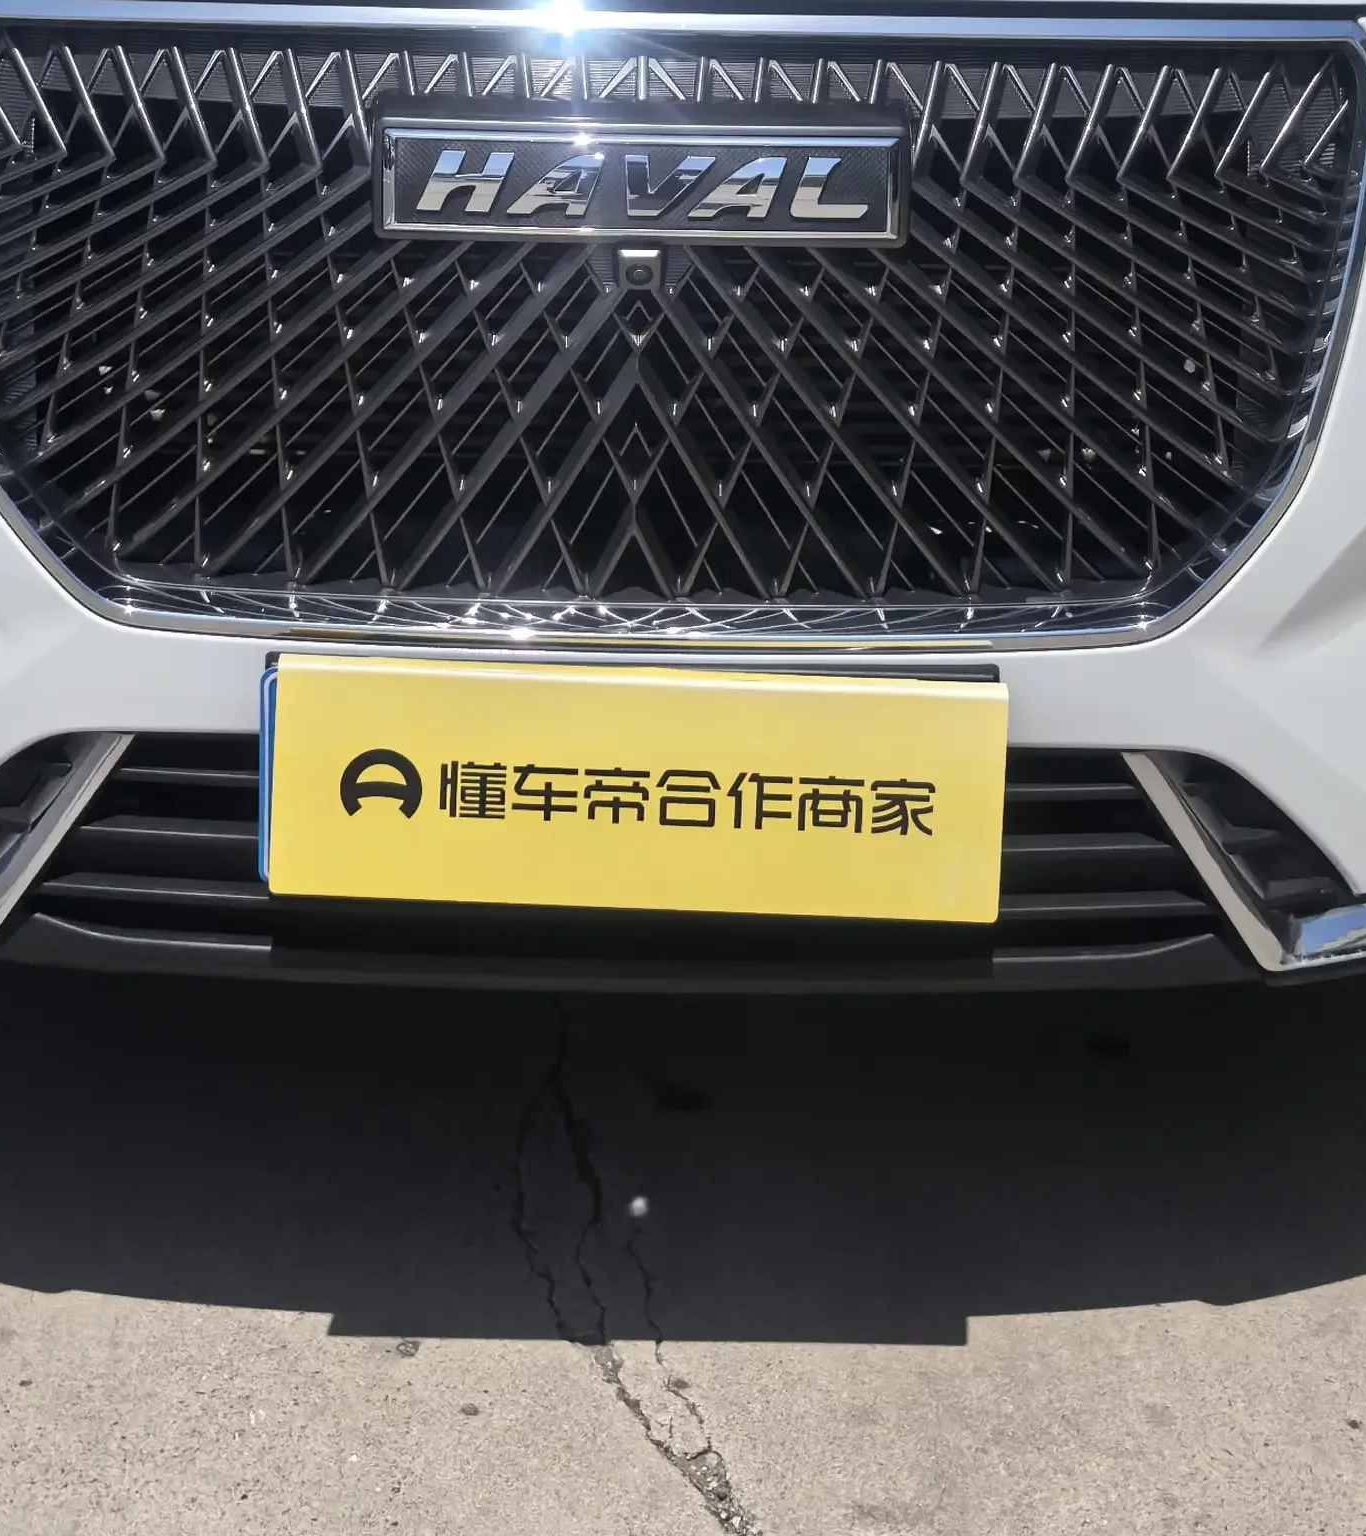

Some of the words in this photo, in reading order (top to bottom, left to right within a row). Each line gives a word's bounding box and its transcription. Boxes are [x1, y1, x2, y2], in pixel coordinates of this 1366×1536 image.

[415, 149, 870, 219] HAVAL
[439, 760, 936, 836] 懂车帝合作商家
